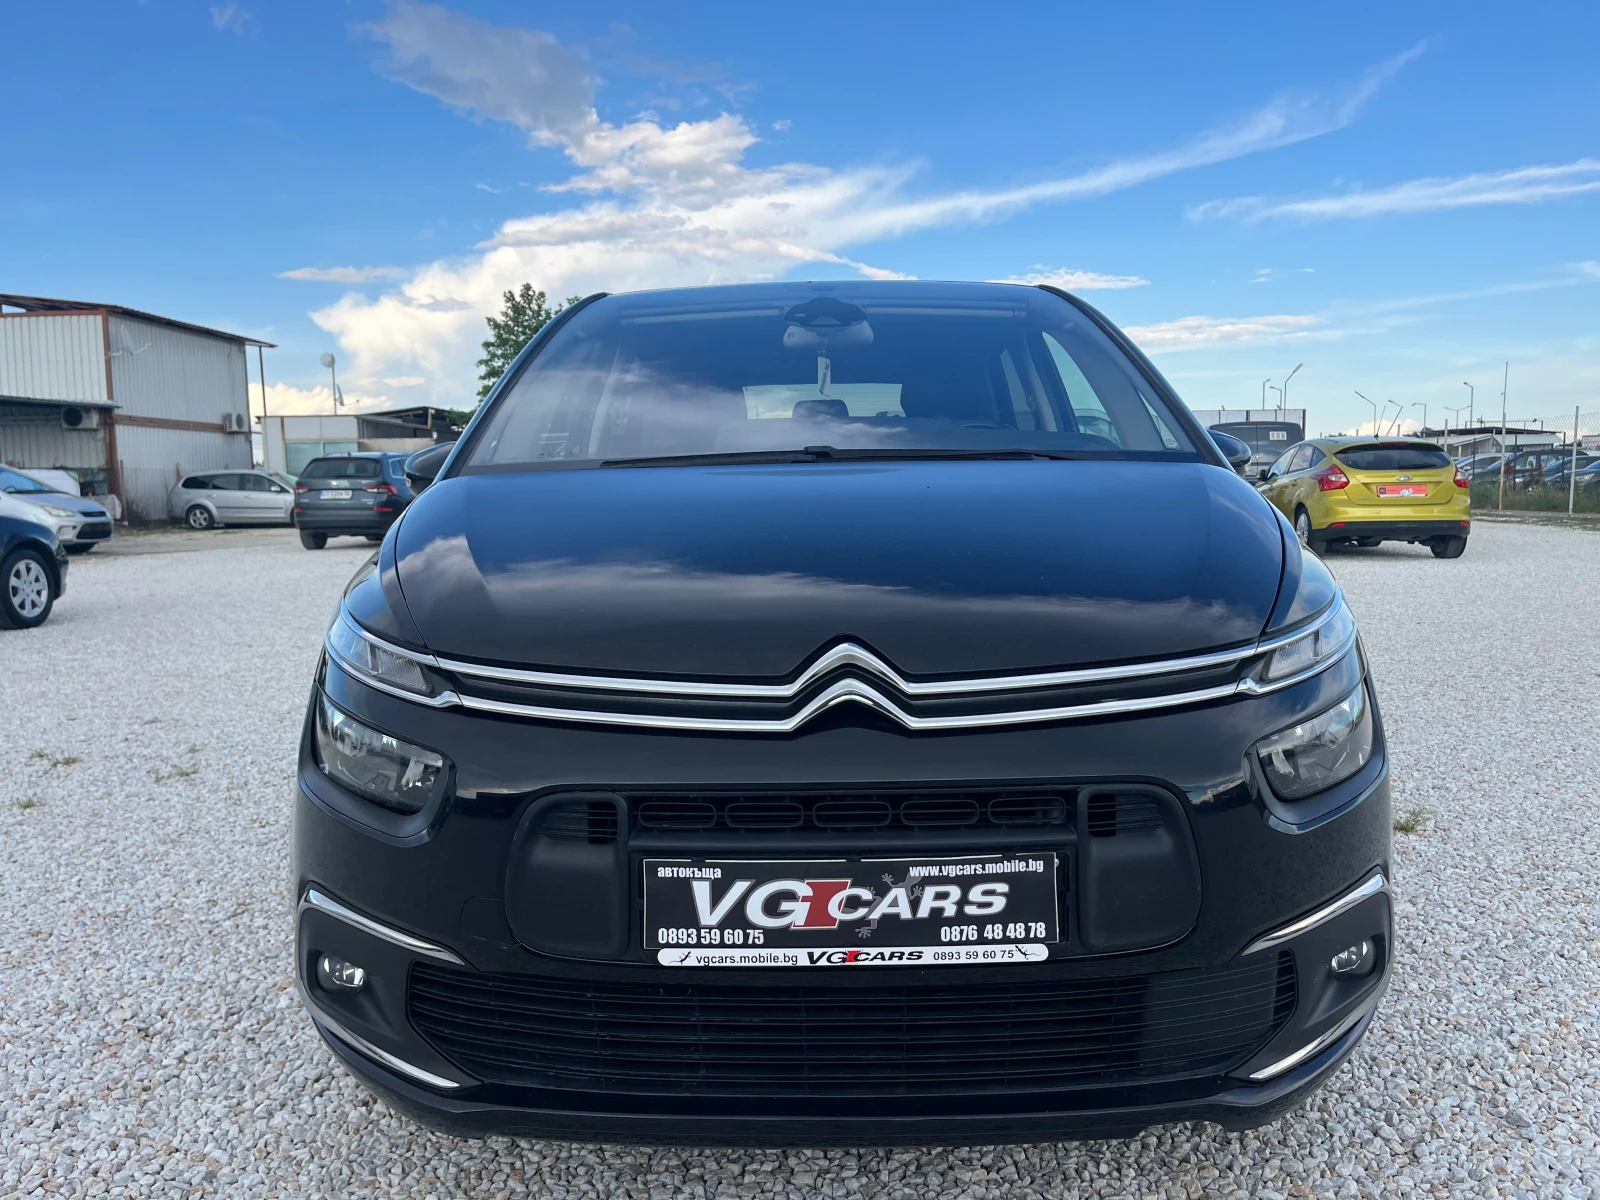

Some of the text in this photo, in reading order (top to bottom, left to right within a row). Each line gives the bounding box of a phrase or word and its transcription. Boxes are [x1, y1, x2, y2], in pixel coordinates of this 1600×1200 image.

[657, 866, 722, 879] автокъща
[909, 859, 1044, 878] www.vgcars.mobile.bg
[657, 928, 764, 945] 0893 59 60 75
[940, 922, 1046, 942] 0876 48 48 78
[696, 952, 798, 966] vgcars.mobile.bg
[933, 951, 961, 961] 0893
[965, 950, 979, 960] 59
[982, 950, 996, 959] 60
[1000, 949, 1015, 959] 75
